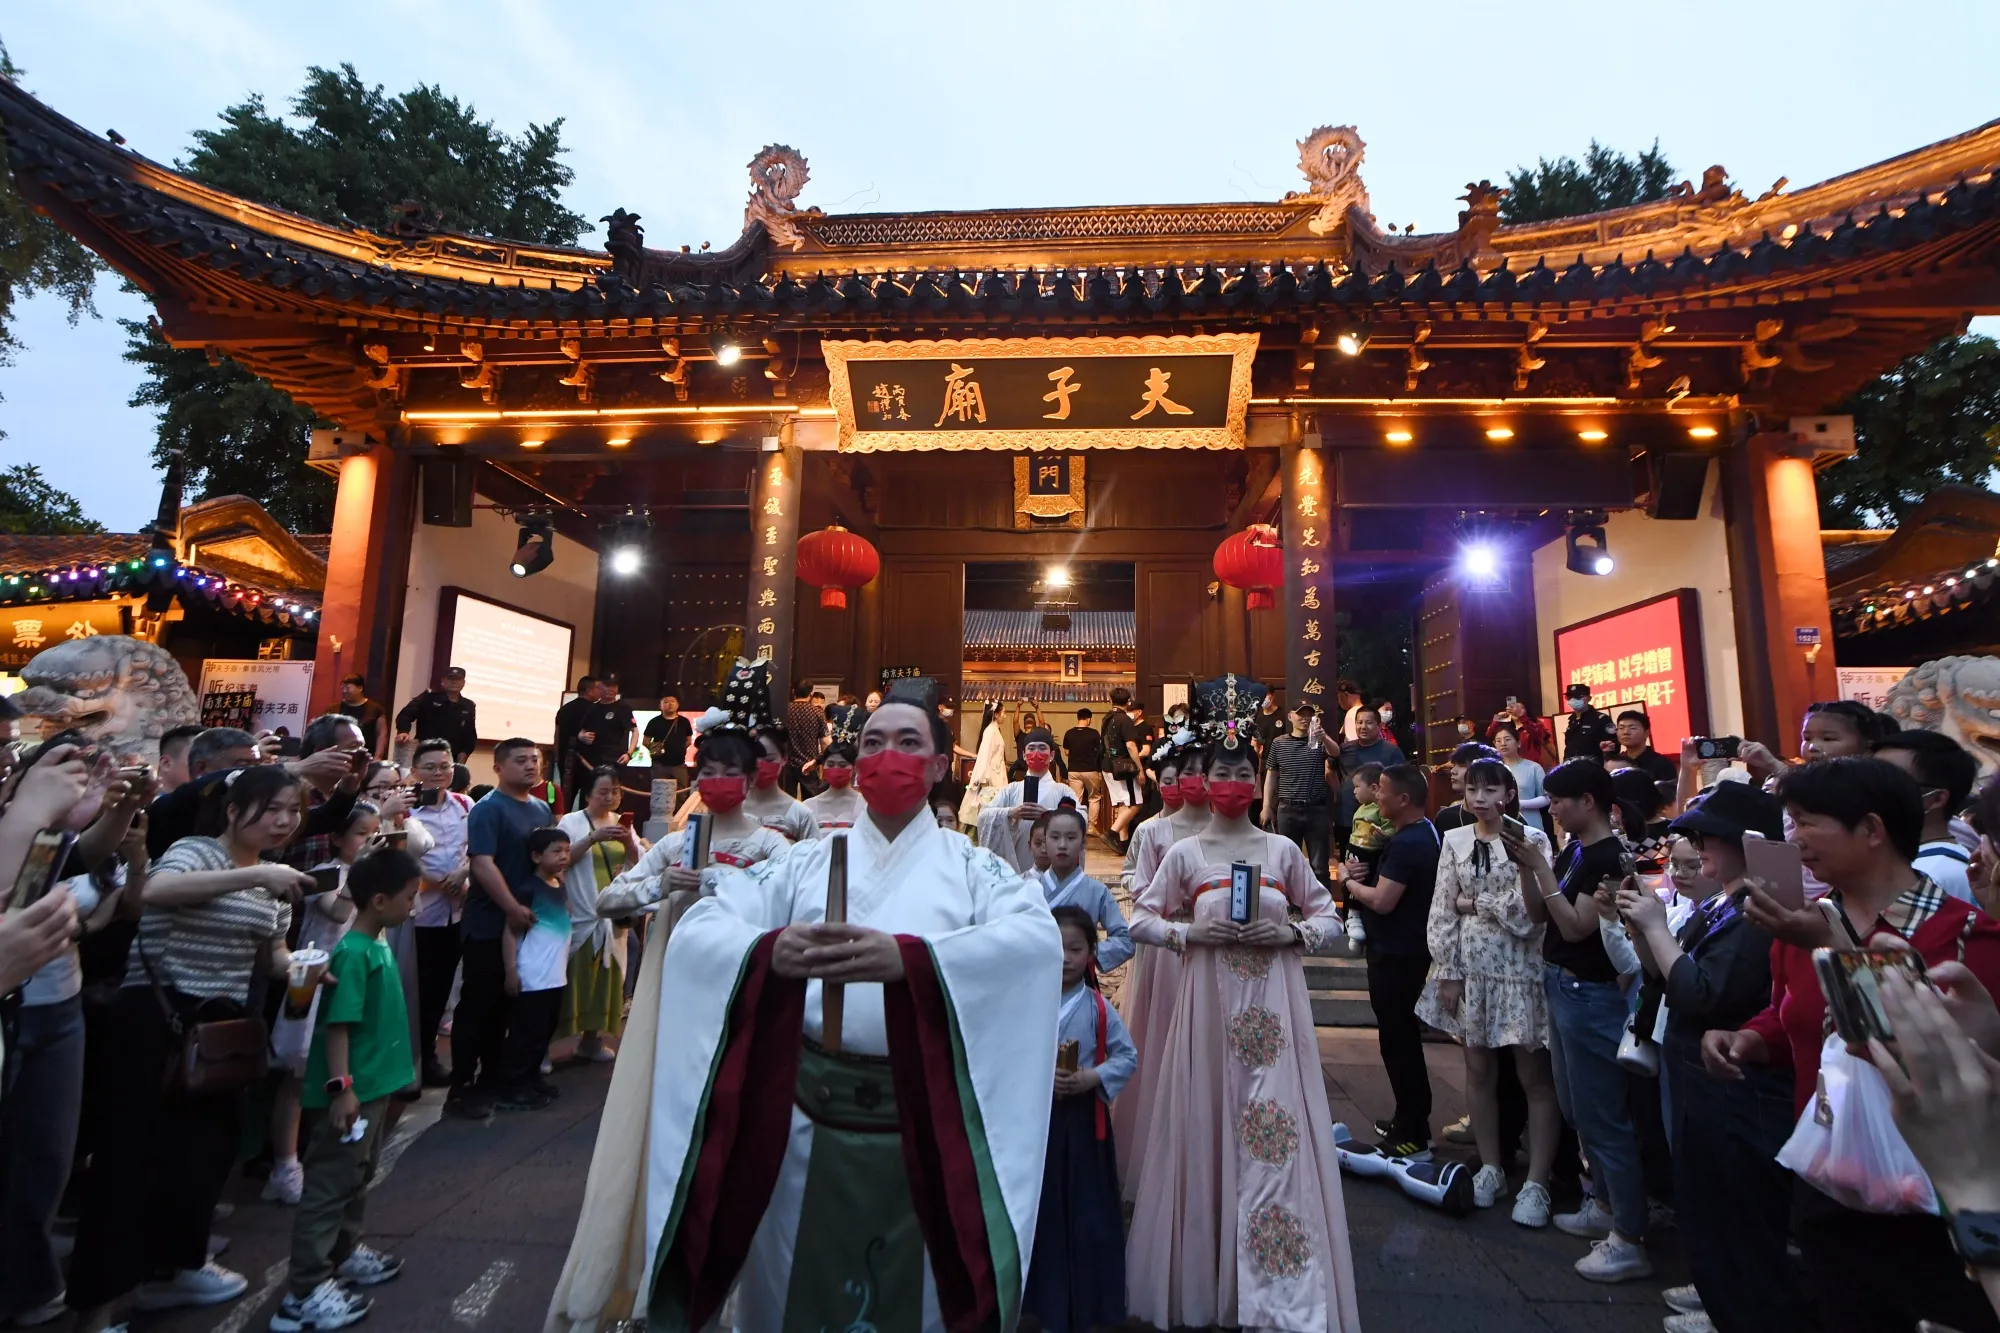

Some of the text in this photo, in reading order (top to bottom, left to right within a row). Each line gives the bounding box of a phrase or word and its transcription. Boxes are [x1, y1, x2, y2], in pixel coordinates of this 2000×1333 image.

[934, 363, 1194, 428] 夫子廟
[756, 466, 784, 685] 至誠至聖與兩間
[881, 666, 921, 679] 南京夫子庙
[204, 694, 252, 709] 南京夫子庙
